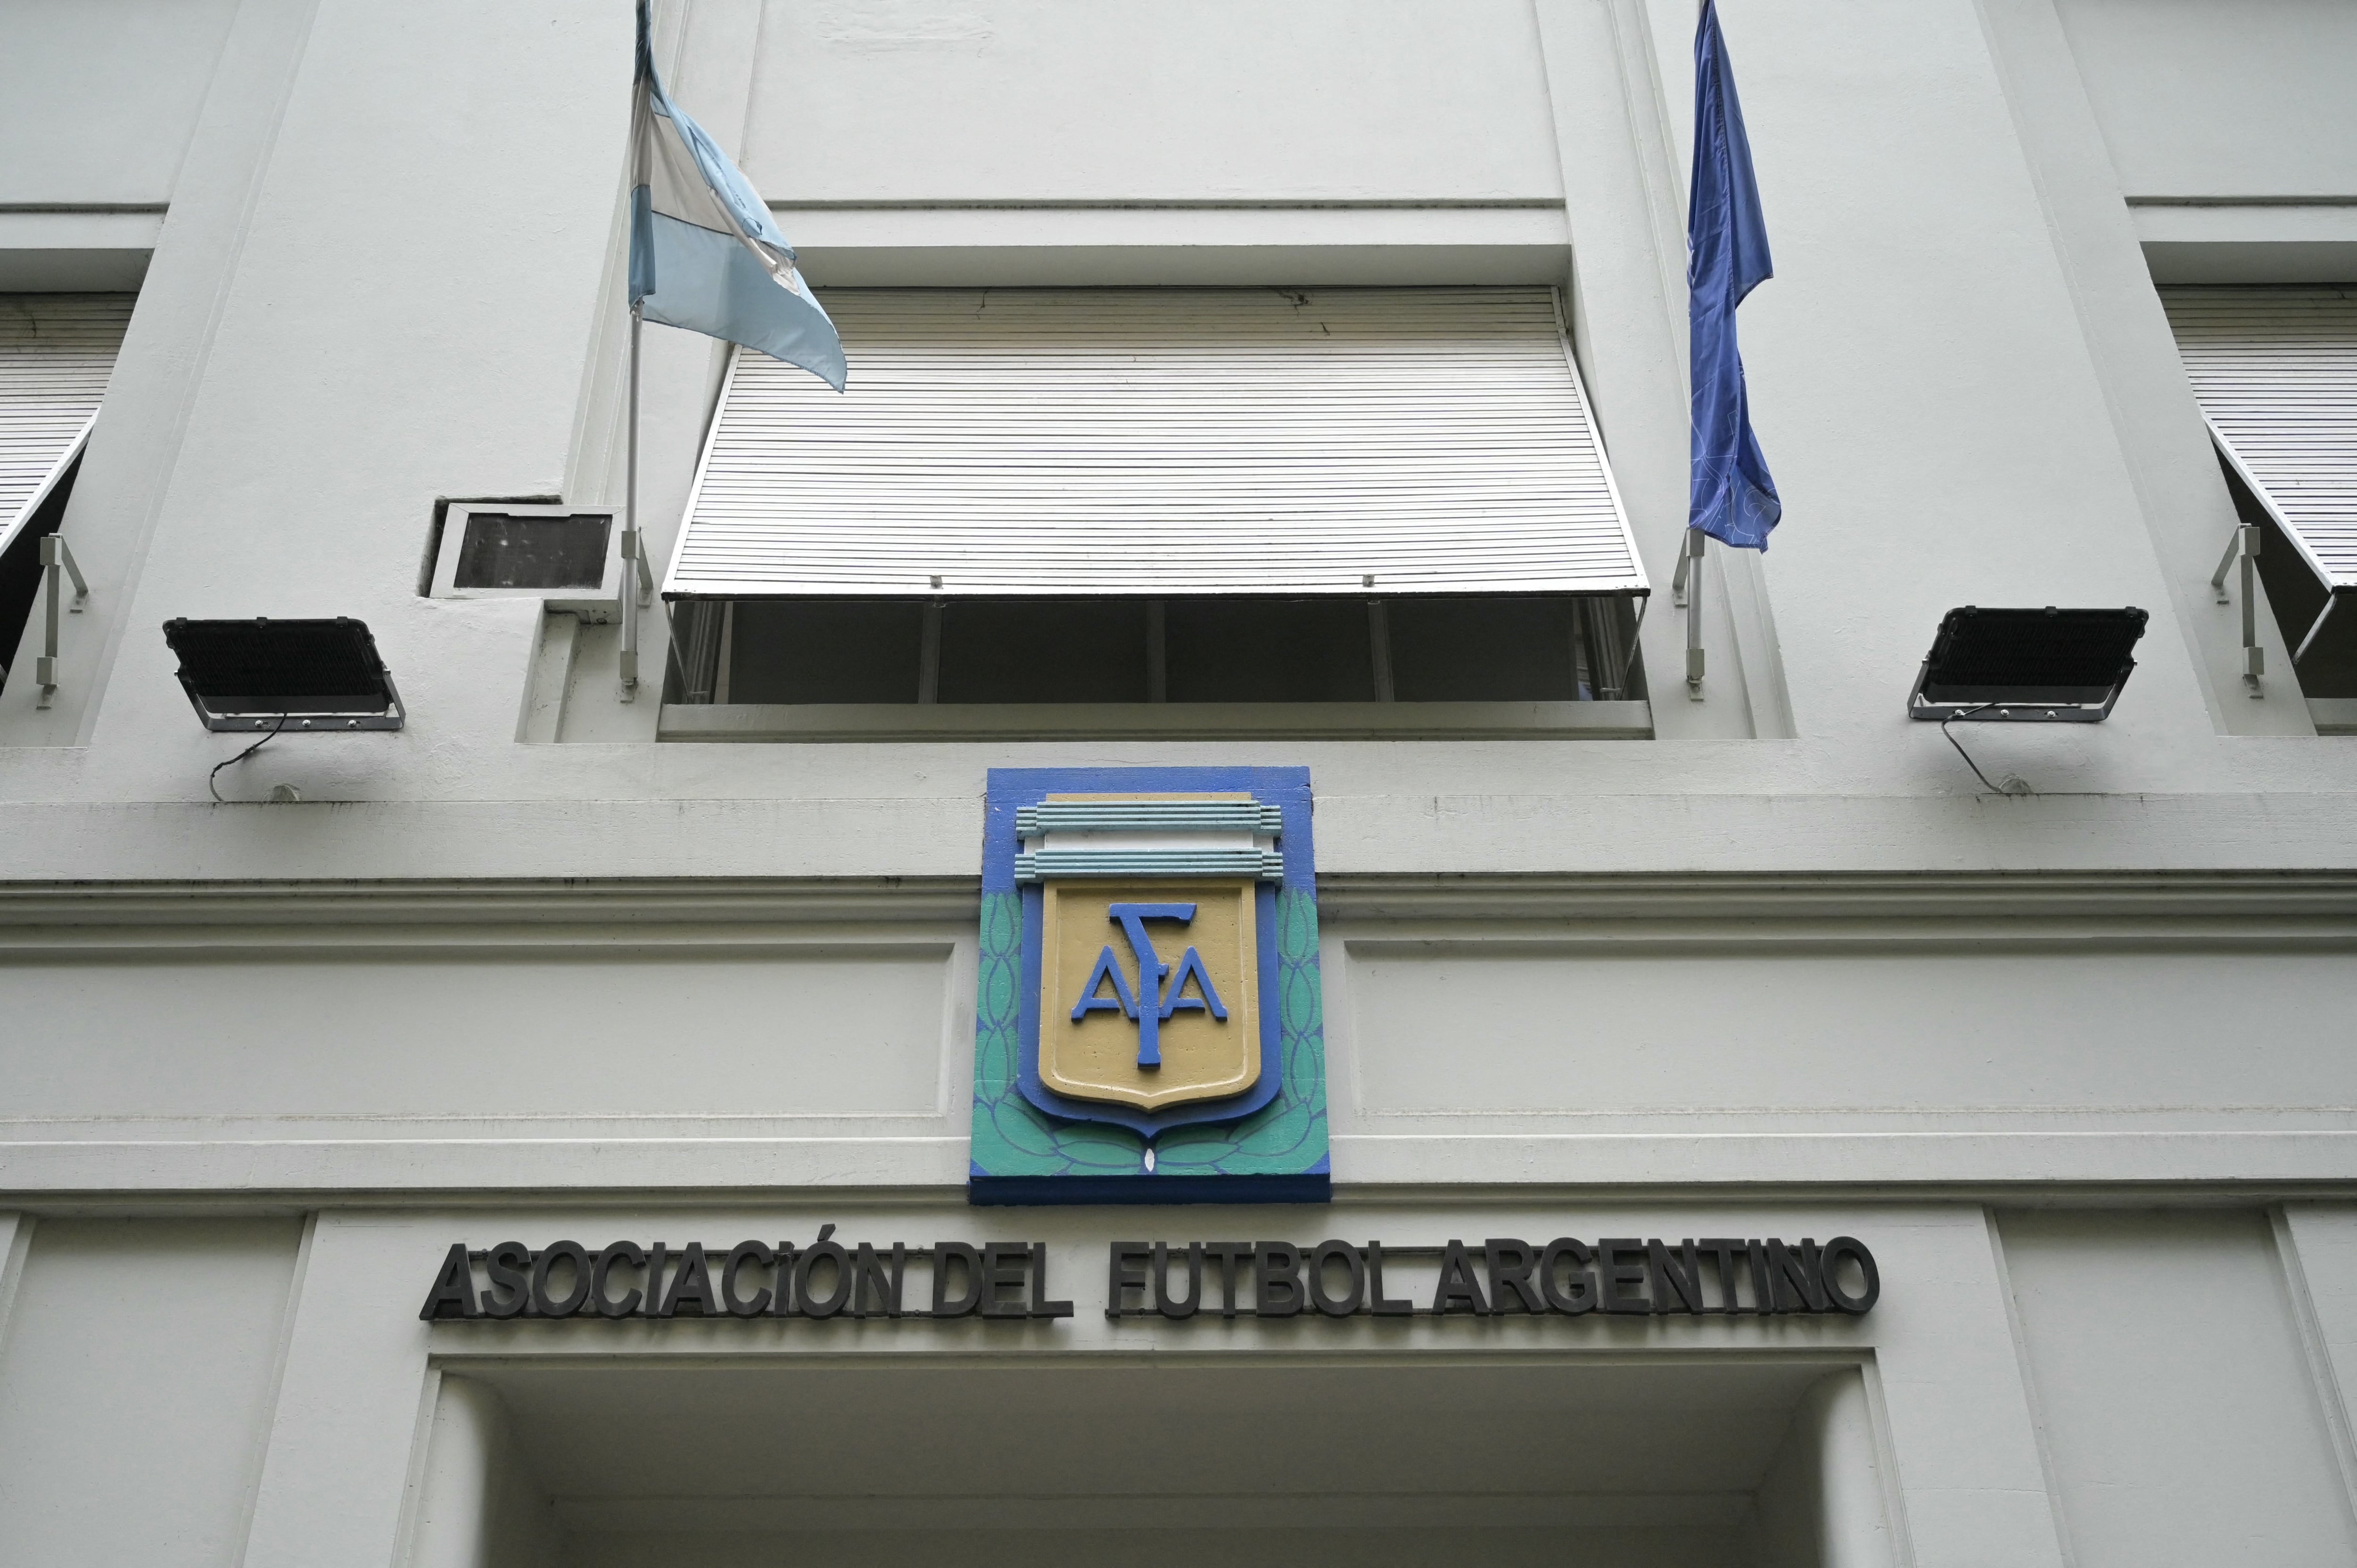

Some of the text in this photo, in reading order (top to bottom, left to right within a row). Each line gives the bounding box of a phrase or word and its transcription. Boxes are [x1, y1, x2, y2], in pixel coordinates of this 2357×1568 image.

[1071, 903, 1228, 1067] AFA
[420, 1223, 1880, 1320] ASOCIACIÓN DEL FUTBOL ARGENTINO
